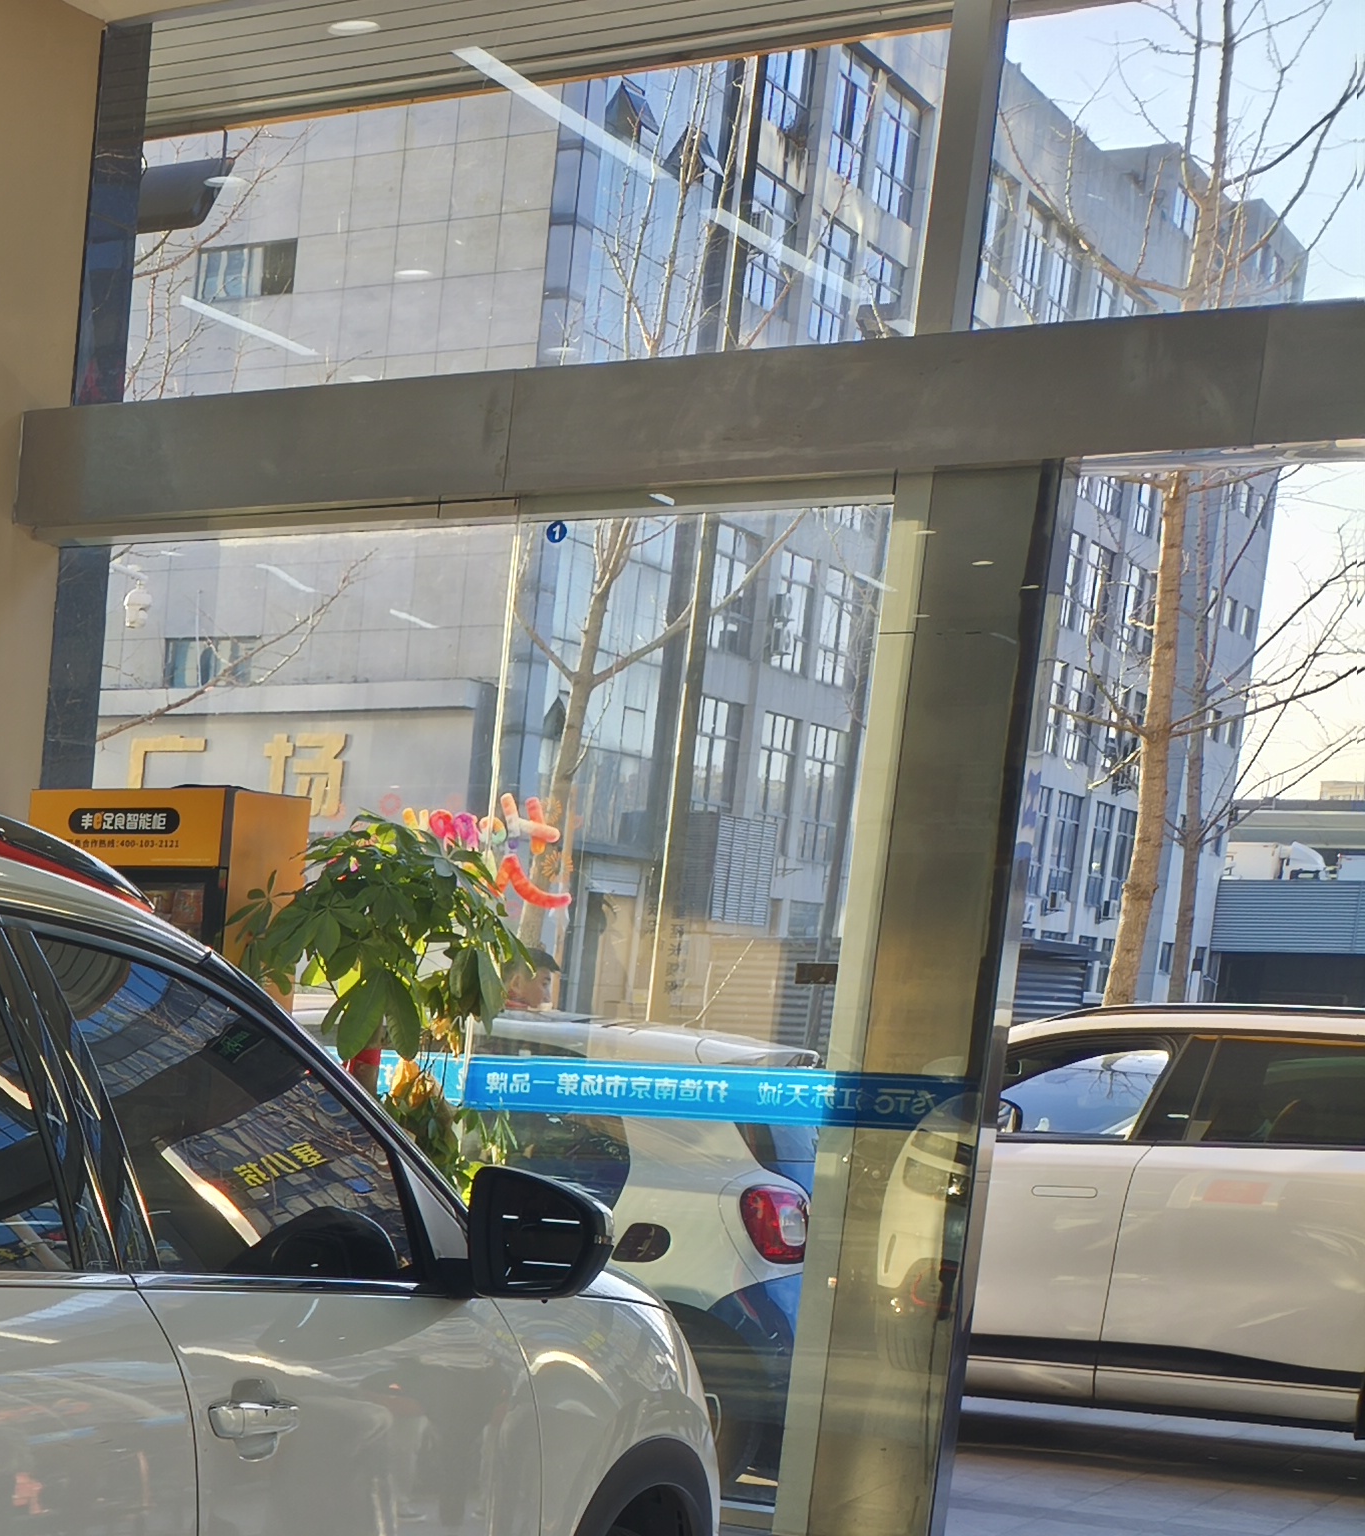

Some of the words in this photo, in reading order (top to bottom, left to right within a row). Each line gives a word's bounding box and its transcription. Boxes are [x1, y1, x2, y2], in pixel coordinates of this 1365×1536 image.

[81, 811, 167, 831] 丰e足食智能柜
